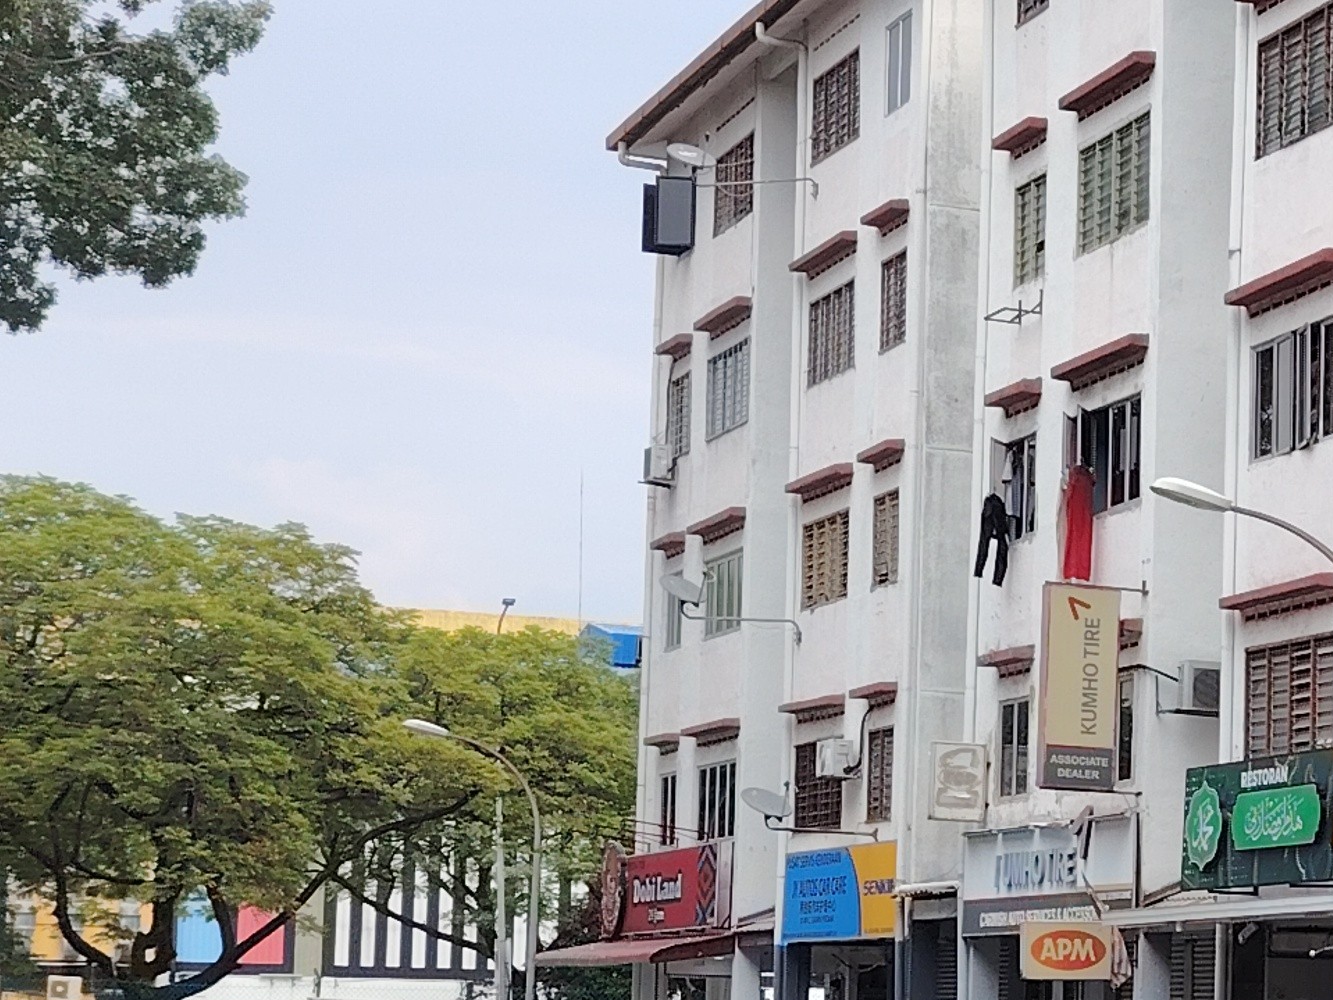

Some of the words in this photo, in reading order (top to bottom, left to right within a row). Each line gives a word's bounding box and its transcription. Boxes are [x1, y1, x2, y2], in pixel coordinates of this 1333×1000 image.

[1084, 618, 1100, 659] TIRE
[1081, 663, 1098, 735] KUMHO
[1050, 754, 1110, 768] ASSOCIATE
[1057, 767, 1100, 780] DEALER
[1240, 765, 1289, 788] RESTORAN
[633, 875, 656, 904] Dobi
[657, 872, 683, 901] Land
[1040, 938, 1096, 962] APM
